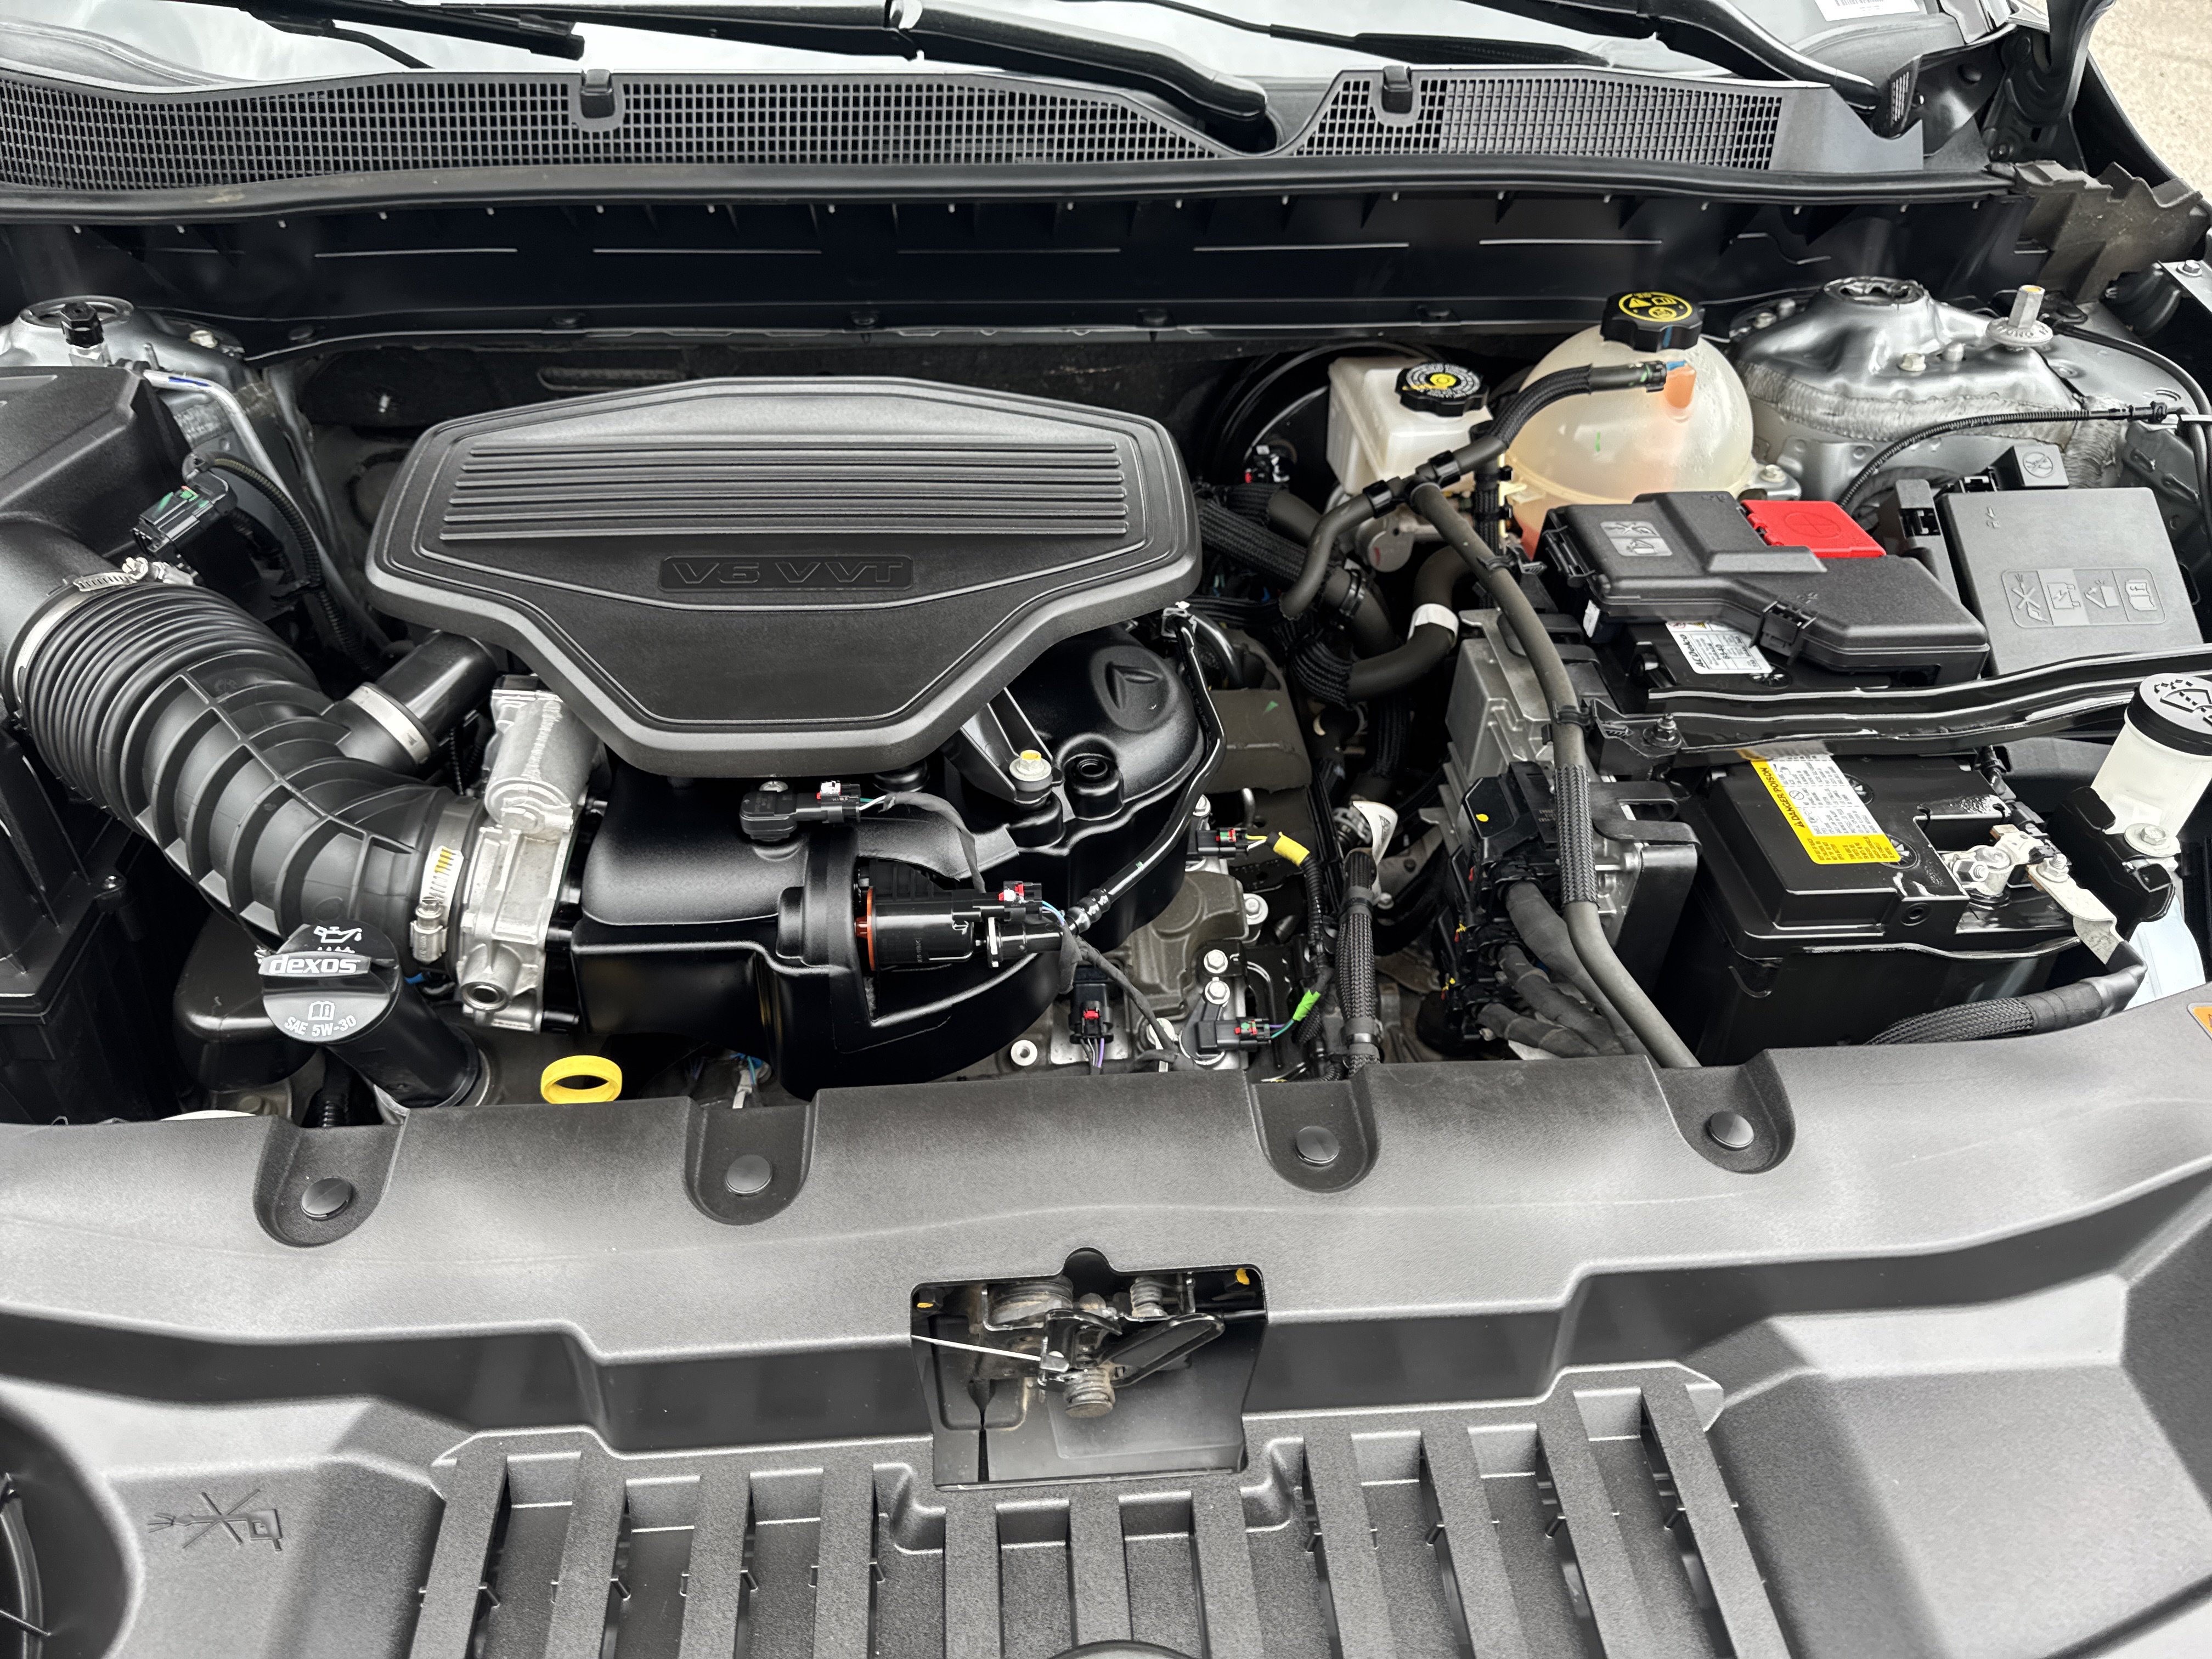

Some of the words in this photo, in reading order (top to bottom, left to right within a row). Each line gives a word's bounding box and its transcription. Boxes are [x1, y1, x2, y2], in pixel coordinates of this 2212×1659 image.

[673, 562, 760, 584] V6
[775, 561, 903, 583] VVT
[1679, 634, 1706, 668] ACDelco
[284, 1016, 309, 1035] SAE
[312, 1015, 357, 1037] 5W-30
